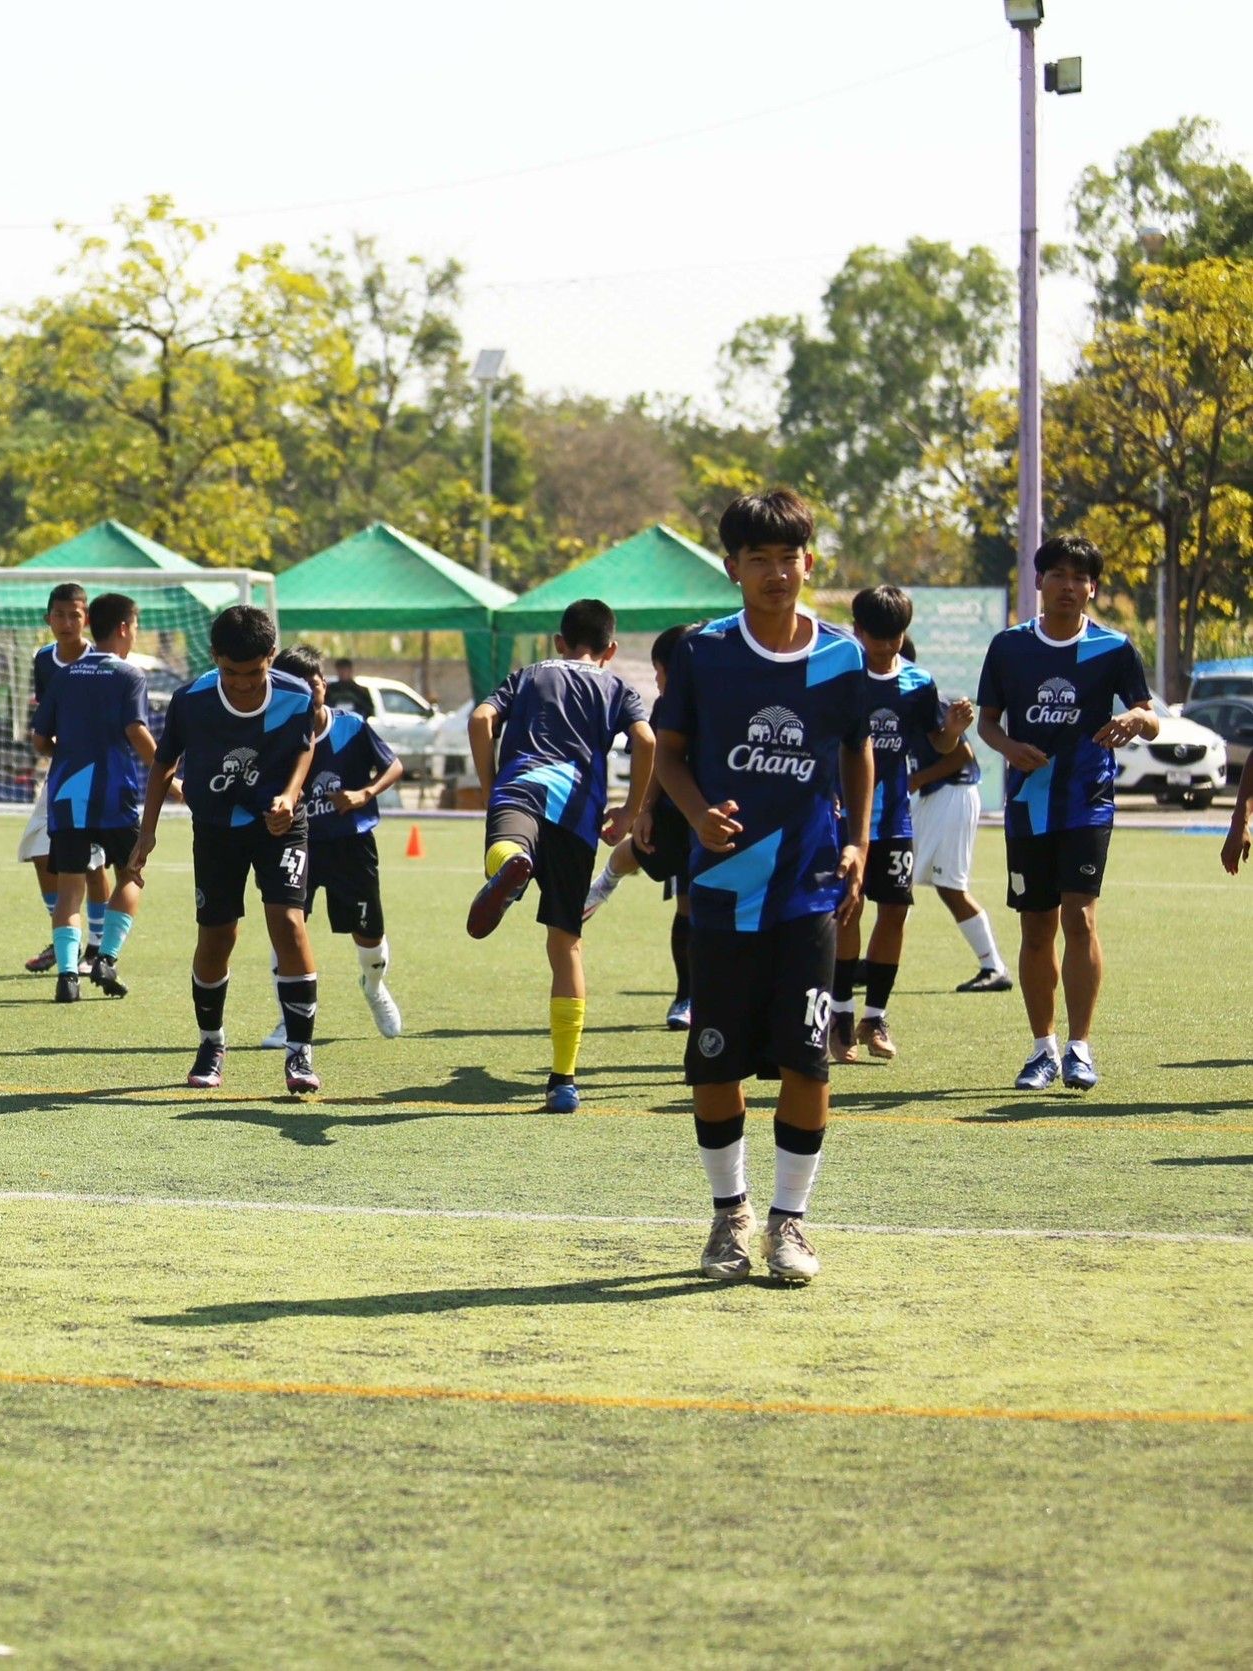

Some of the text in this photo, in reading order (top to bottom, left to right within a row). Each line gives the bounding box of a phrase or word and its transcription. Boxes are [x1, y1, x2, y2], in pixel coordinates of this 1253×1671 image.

[727, 744, 816, 782] Chang
[887, 851, 913, 876] 39
[357, 902, 367, 919] 7
[804, 987, 831, 1031] 10
